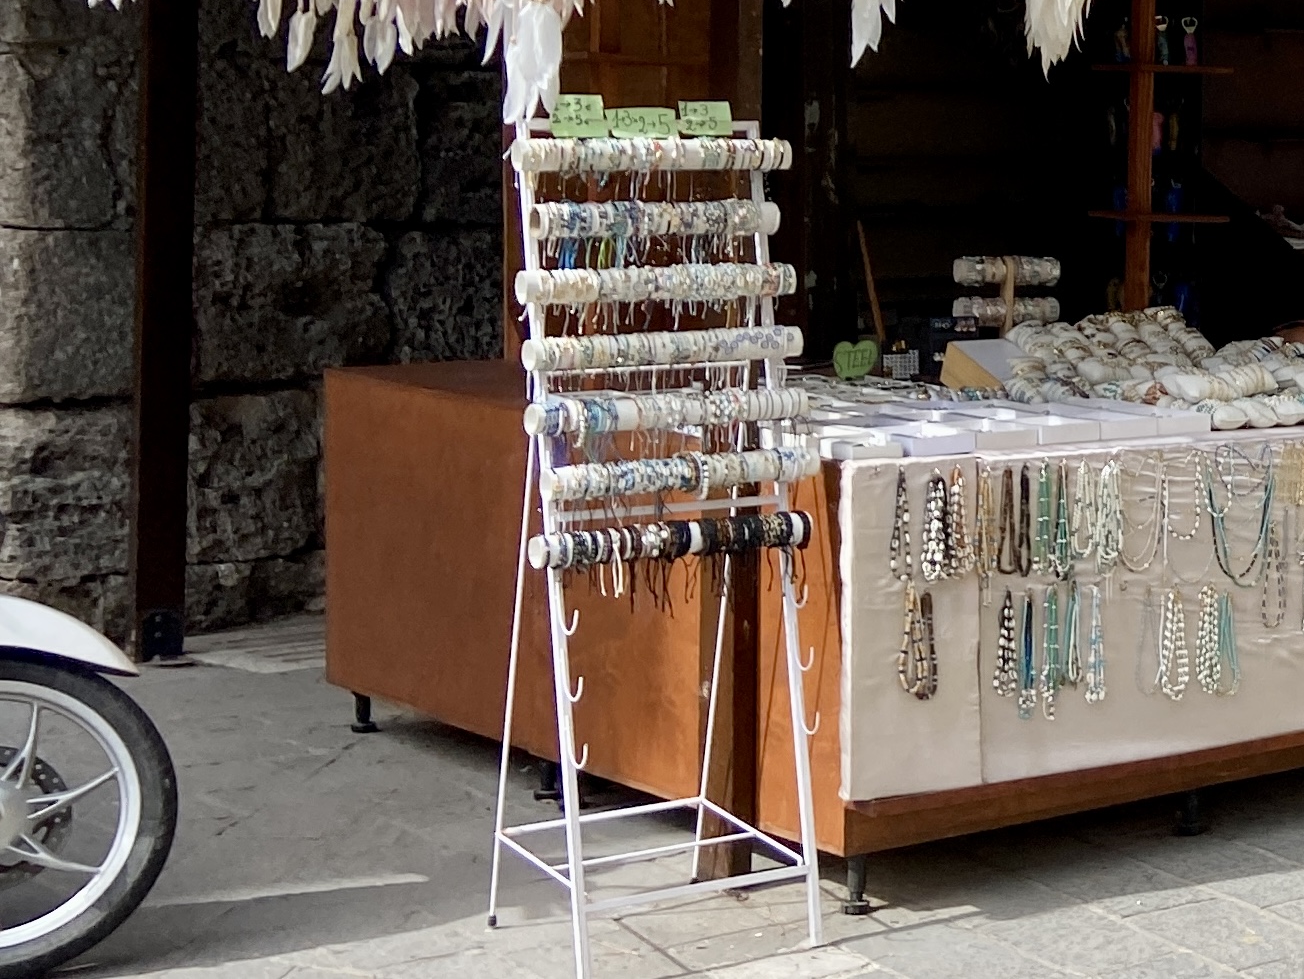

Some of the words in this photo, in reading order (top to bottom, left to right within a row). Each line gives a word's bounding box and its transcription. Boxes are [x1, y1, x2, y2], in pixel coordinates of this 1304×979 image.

[573, 98, 582, 112] 3
[681, 102, 688, 117] 1
[700, 104, 709, 117] 3
[552, 113, 561, 123] 2
[657, 114, 671, 135] 5
[685, 118, 696, 132] 2
